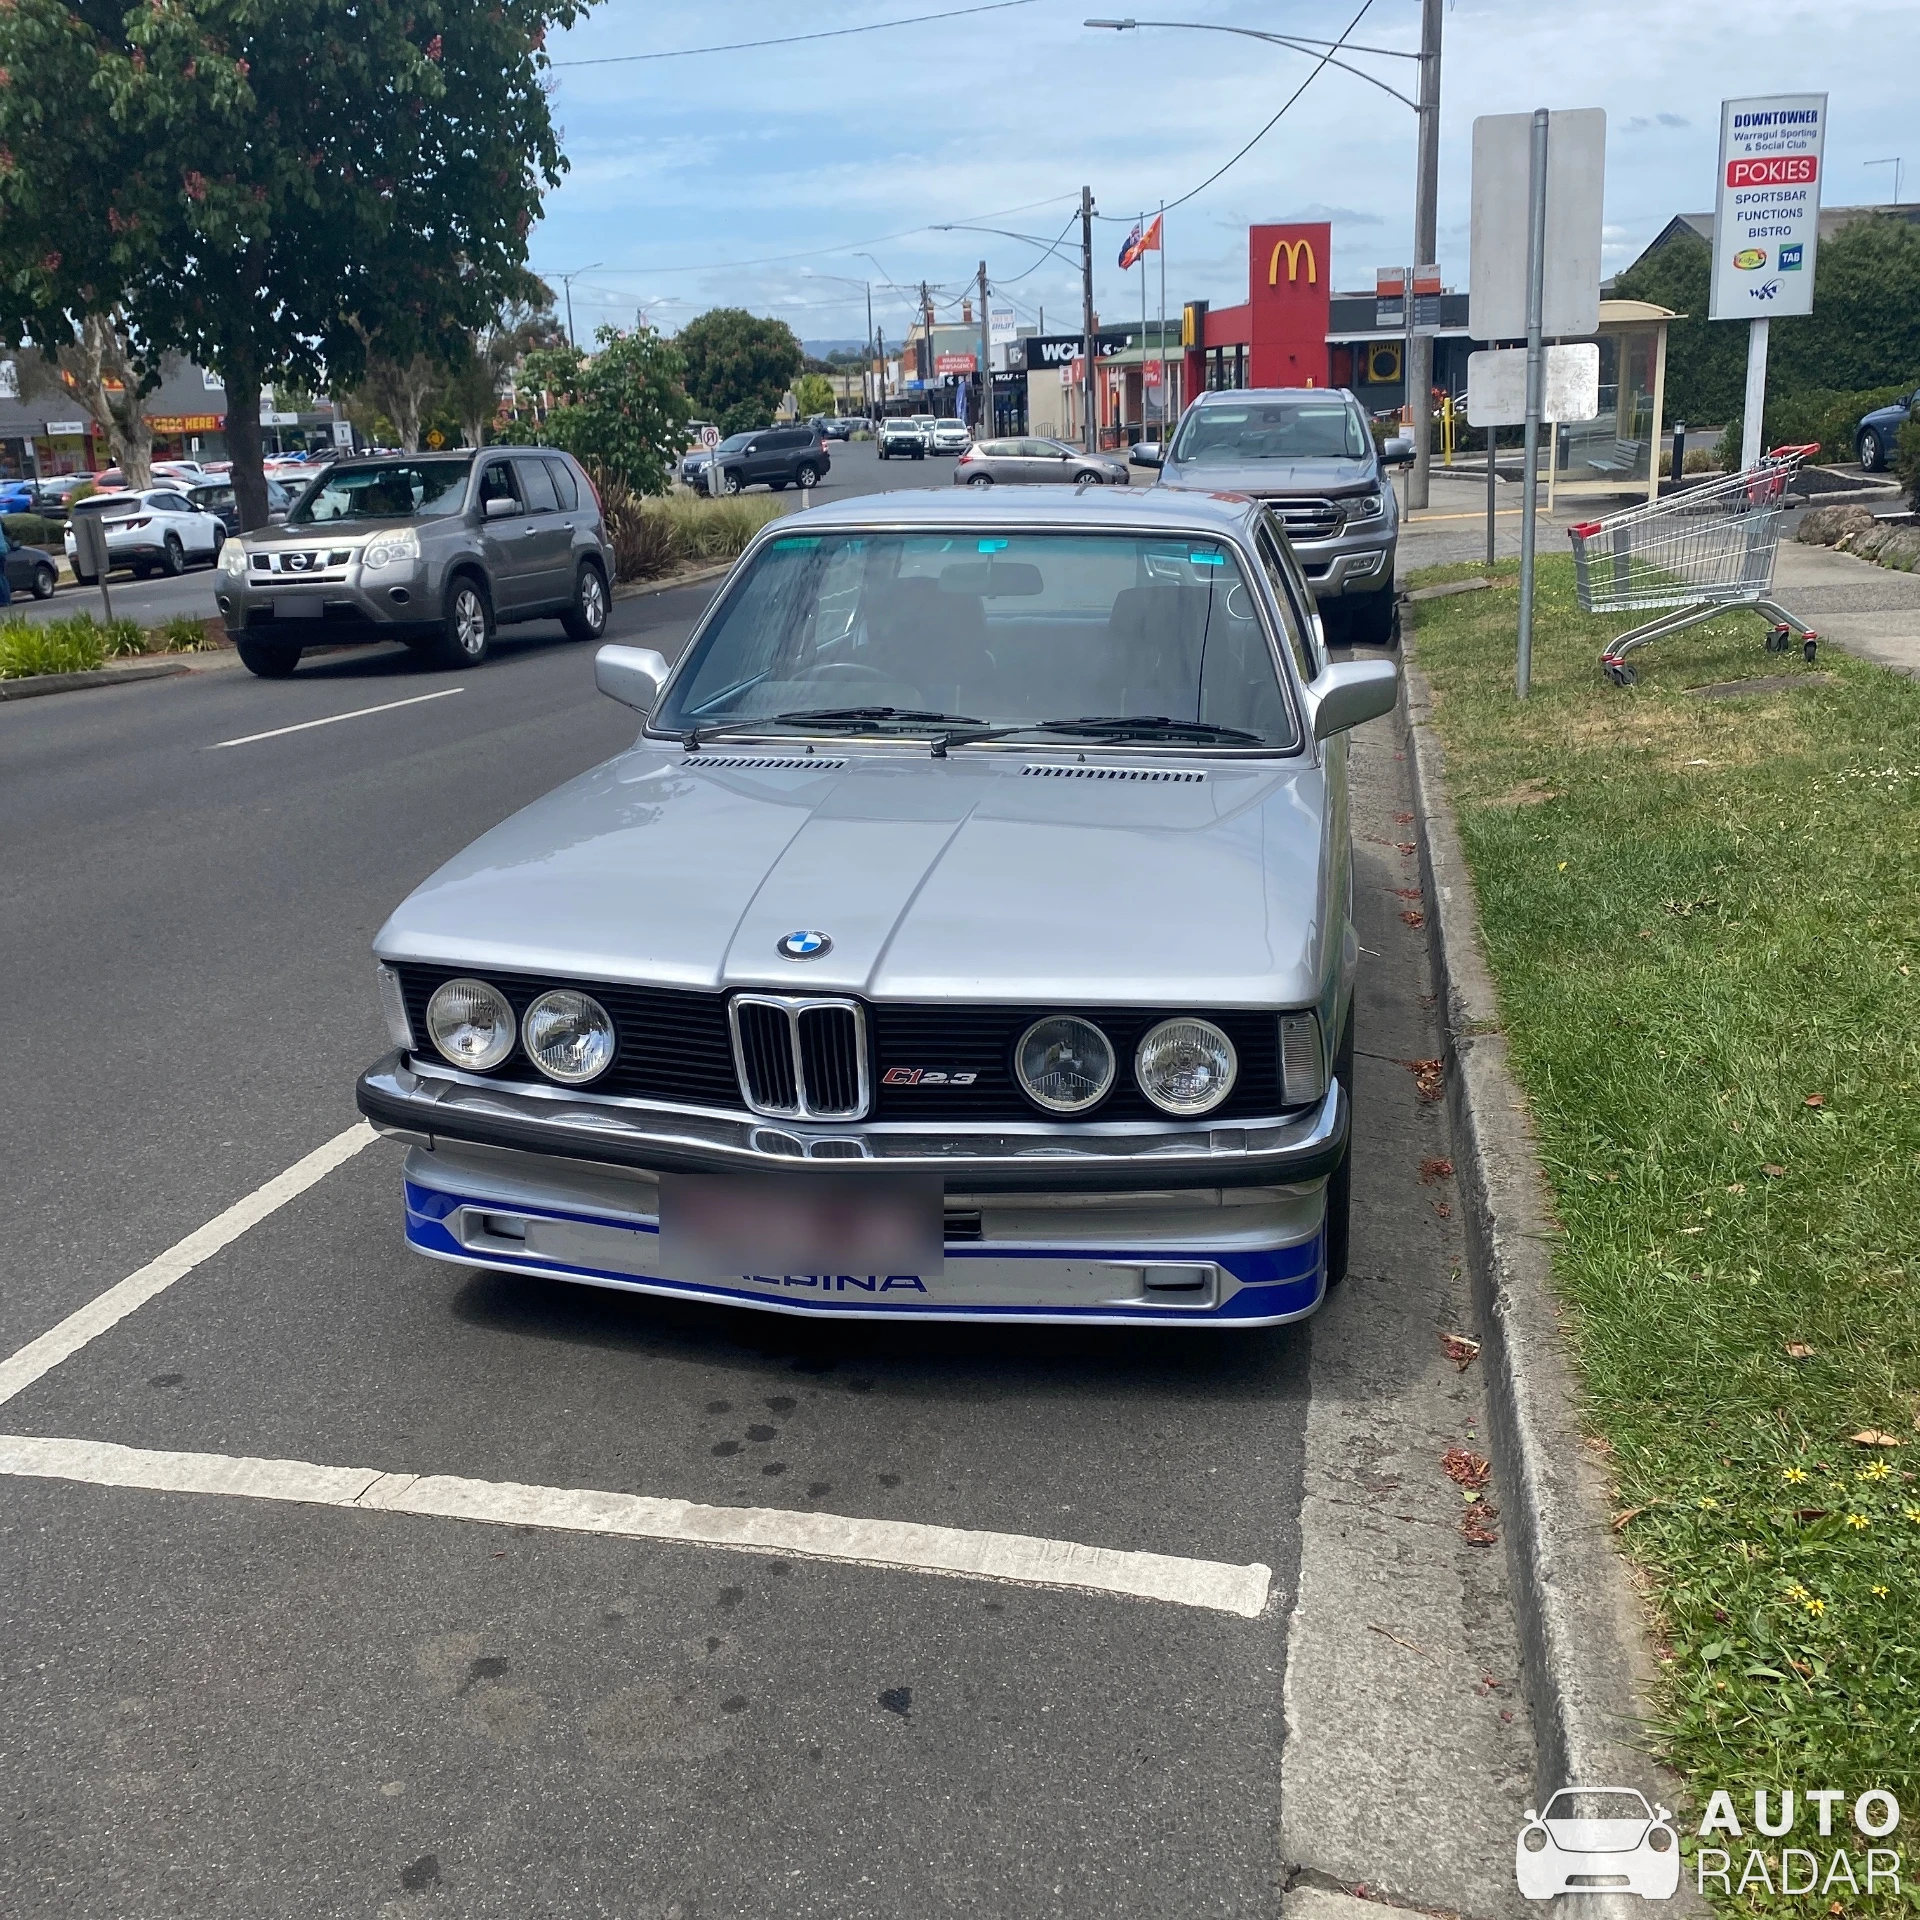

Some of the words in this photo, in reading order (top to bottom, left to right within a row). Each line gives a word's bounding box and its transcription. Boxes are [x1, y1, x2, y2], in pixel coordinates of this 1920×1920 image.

[1734, 110, 1818, 128] DOWNTOWNER
[1734, 130, 1778, 141] Warragul
[1780, 129, 1817, 138] Sporting
[1745, 143, 1752, 151] &
[1755, 141, 1784, 151] Social
[1787, 140, 1807, 149] Club
[1735, 160, 1810, 184] POKIES
[1735, 190, 1807, 204] SPORTSBAR
[1737, 208, 1803, 221] FUNCTIONS
[1748, 226, 1792, 238] BISTRO
[1782, 252, 1800, 263] TAB
[1041, 343, 1085, 361] WOL
[995, 373, 1013, 381] WOLF
